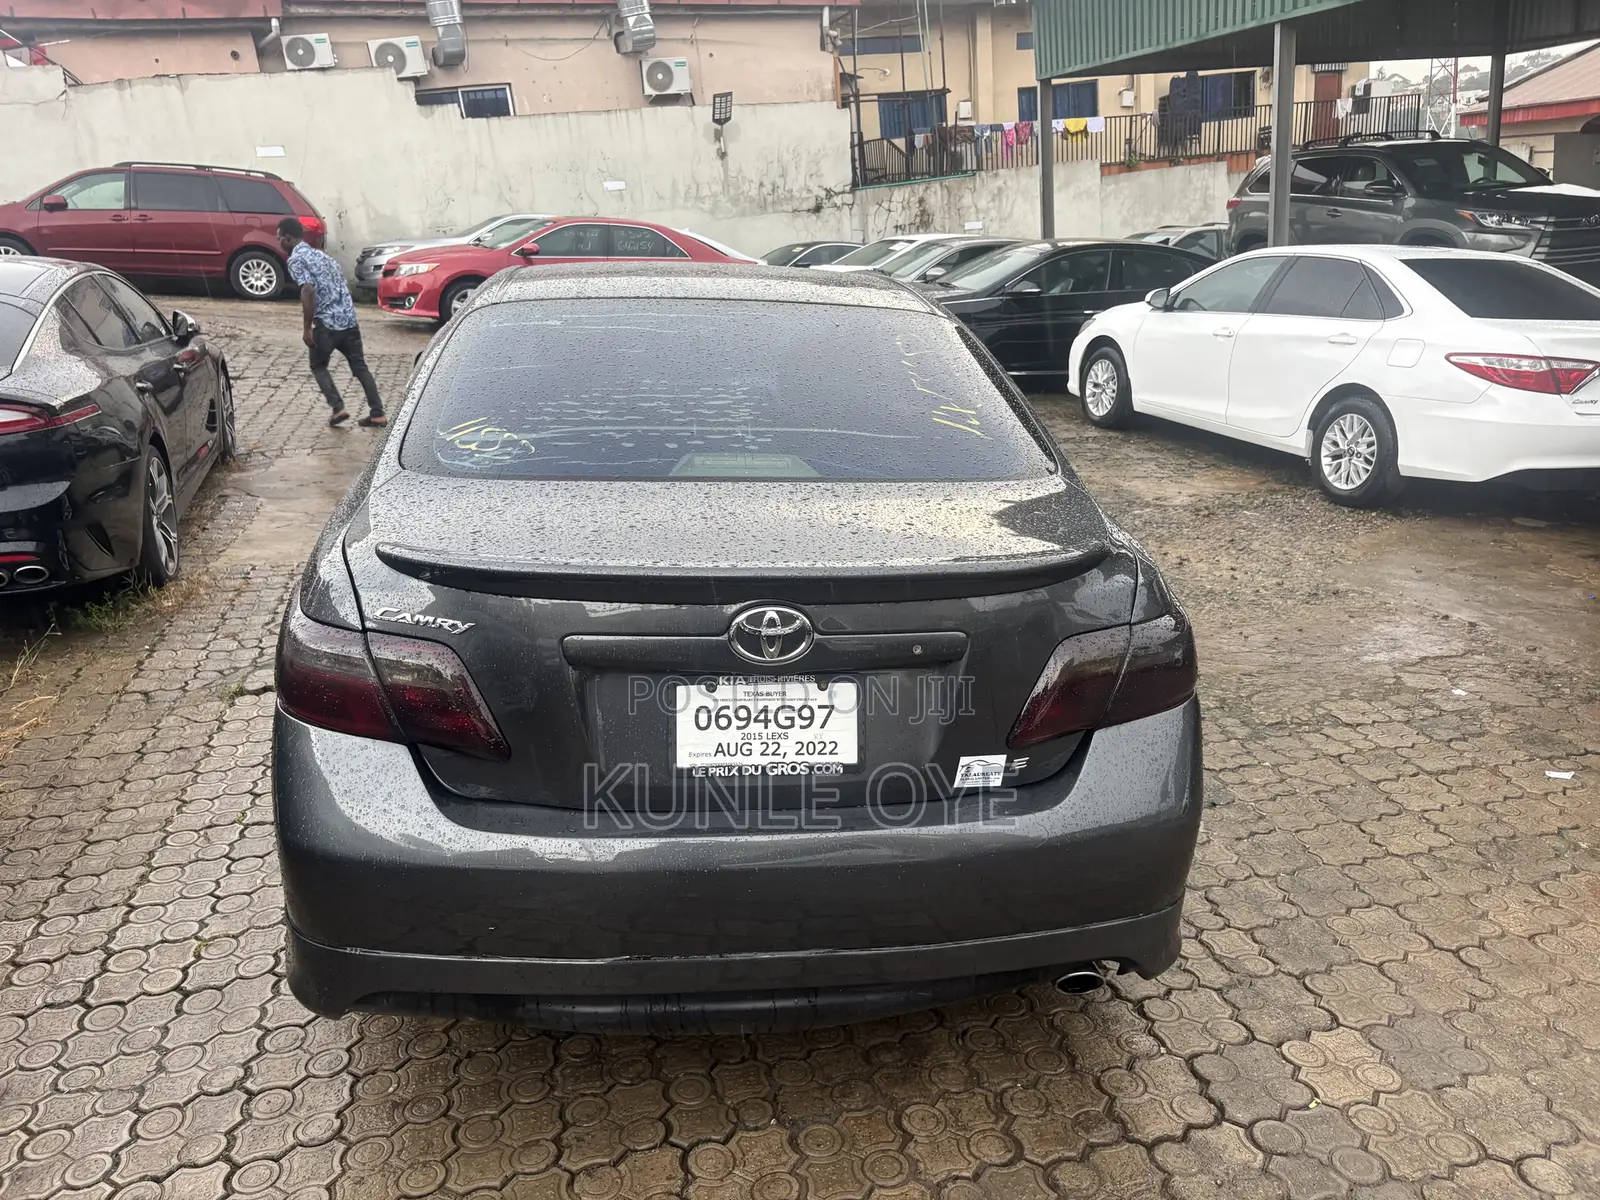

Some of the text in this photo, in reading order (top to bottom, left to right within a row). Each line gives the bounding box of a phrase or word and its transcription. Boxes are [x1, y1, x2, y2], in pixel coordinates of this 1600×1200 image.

[373, 607, 476, 635] CAMRY
[719, 676, 746, 686] KIA
[694, 704, 835, 732] 0694G97
[740, 732, 789, 741] 2015 LEXS
[714, 742, 753, 757] AUG
[760, 742, 788, 759] 22,
[795, 741, 839, 756] 2022
[692, 767, 706, 777] LE
[708, 766, 739, 777] PRIX
[741, 765, 762, 776] DU
